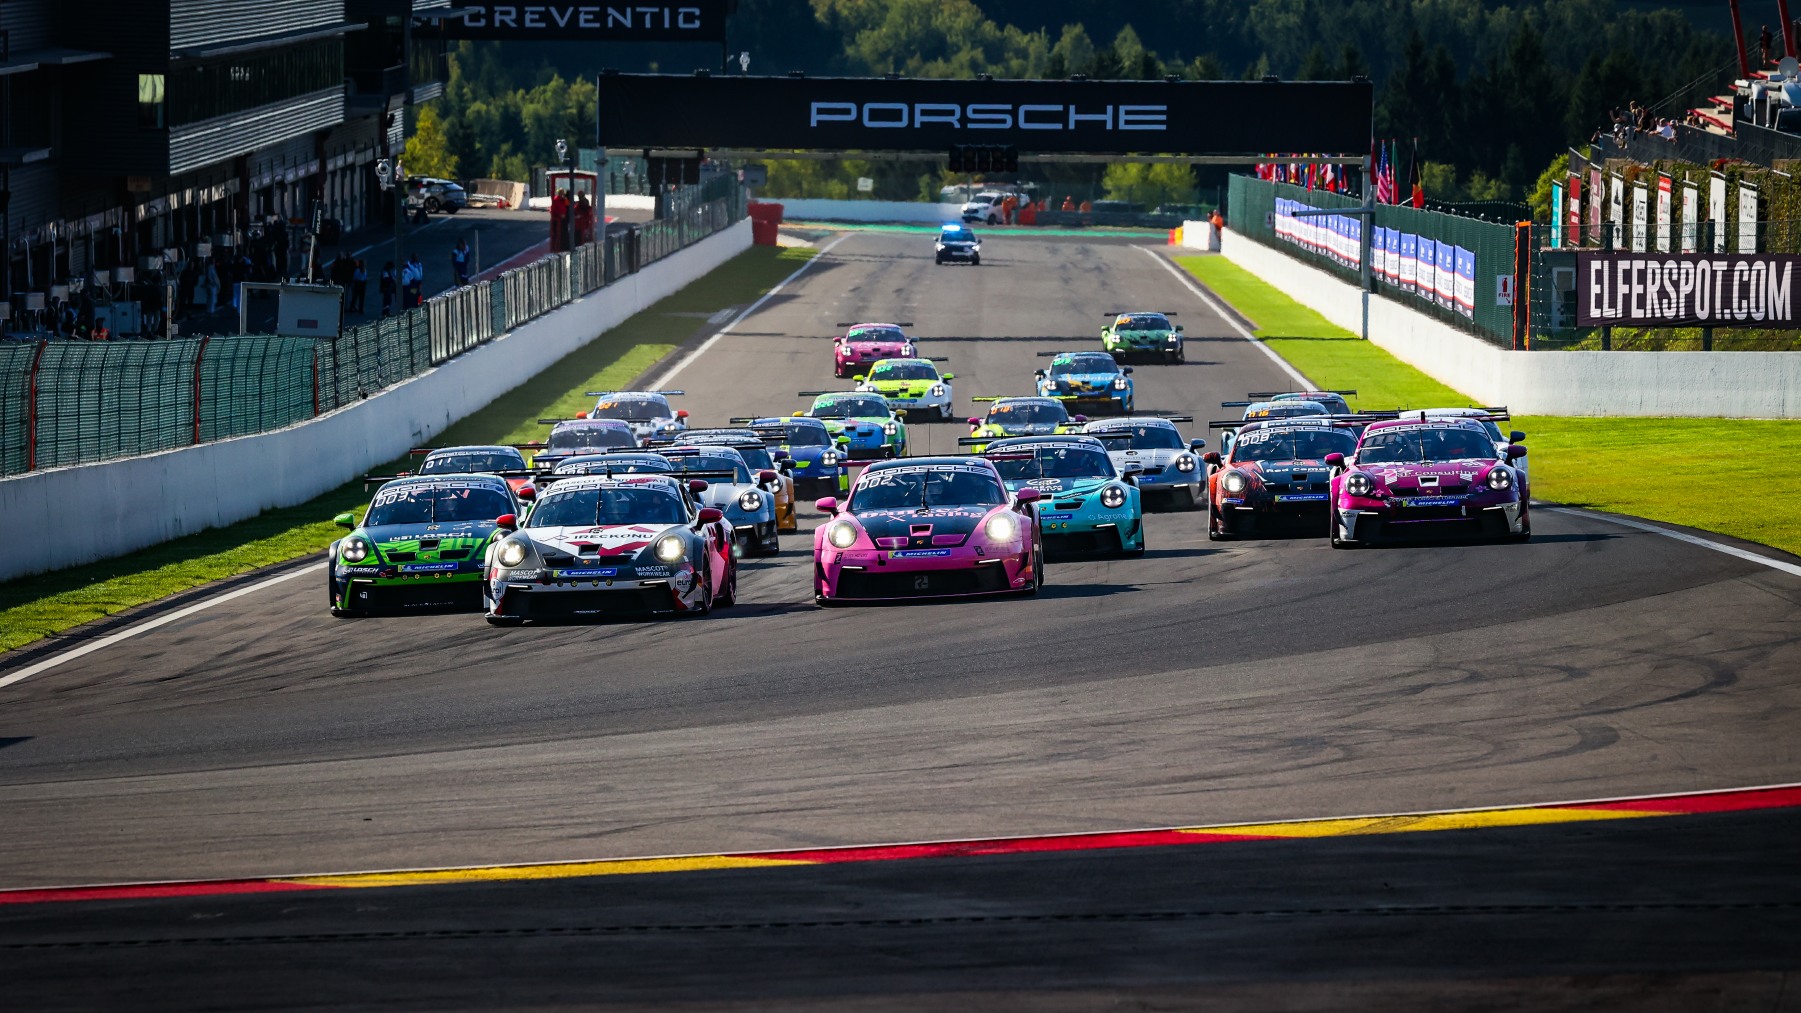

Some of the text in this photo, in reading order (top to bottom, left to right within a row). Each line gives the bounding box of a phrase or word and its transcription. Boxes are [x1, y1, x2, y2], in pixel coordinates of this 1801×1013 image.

[463, 6, 701, 29] CREVENTIC
[809, 101, 1168, 131] PORSCHE
[1590, 260, 1793, 321] ELFERSPOT.COM
[1240, 433, 1270, 447] 008
[865, 465, 989, 479] PORSCHE
[546, 483, 669, 495] PORSCHE
[857, 475, 893, 491] 002
[375, 491, 409, 507] 003
[1097, 513, 1128, 521] Agrone
